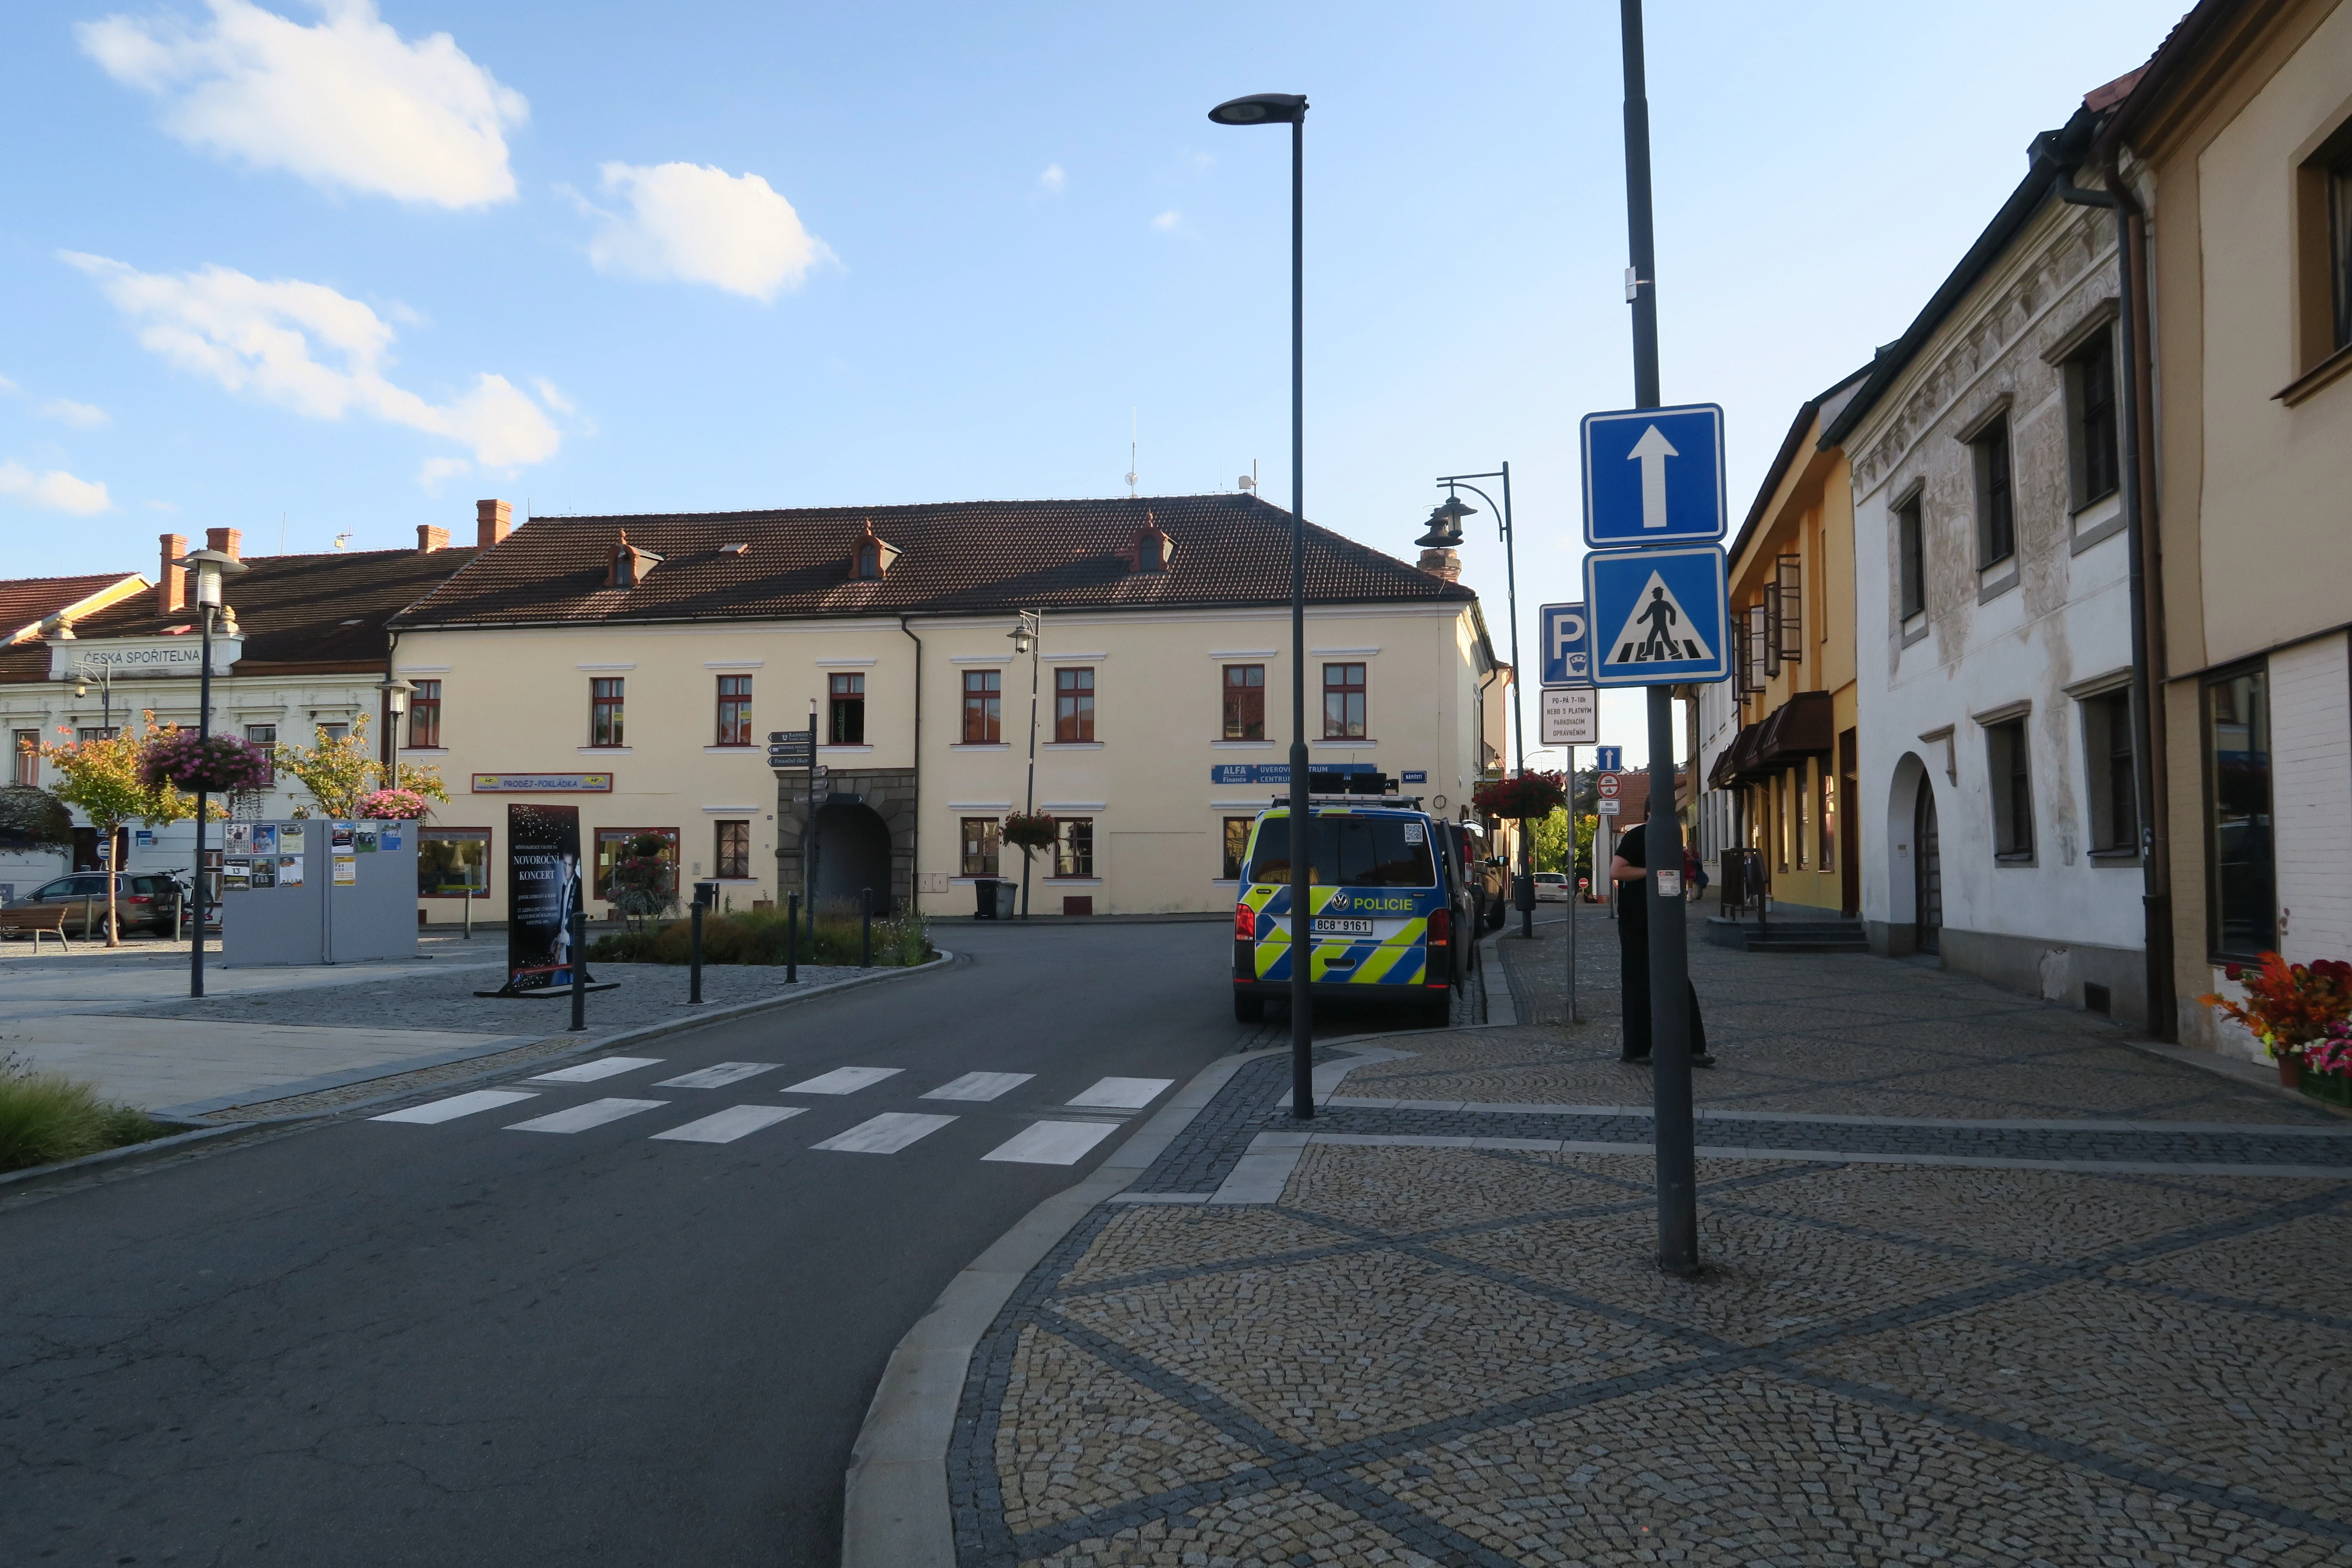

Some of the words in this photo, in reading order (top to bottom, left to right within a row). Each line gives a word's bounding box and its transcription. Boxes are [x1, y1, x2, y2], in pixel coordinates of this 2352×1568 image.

[1553, 614, 1585, 659] P
[84, 650, 122, 664] ČESKÁ
[127, 649, 200, 663] SPOŘITELNA
[1568, 706, 1592, 714] PLATNÝM
[1553, 717, 1585, 726] PARKOVACÍM
[1553, 728, 1586, 736] OPRÁVNĚNÍM
[1223, 766, 1246, 775] ALFA
[514, 853, 559, 865] NOVOROČNÍ
[519, 870, 555, 880] KONCERT
[1354, 898, 1413, 911] POLICIE
[1317, 920, 1335, 930] 8C8
[1343, 921, 1367, 931] 9161
